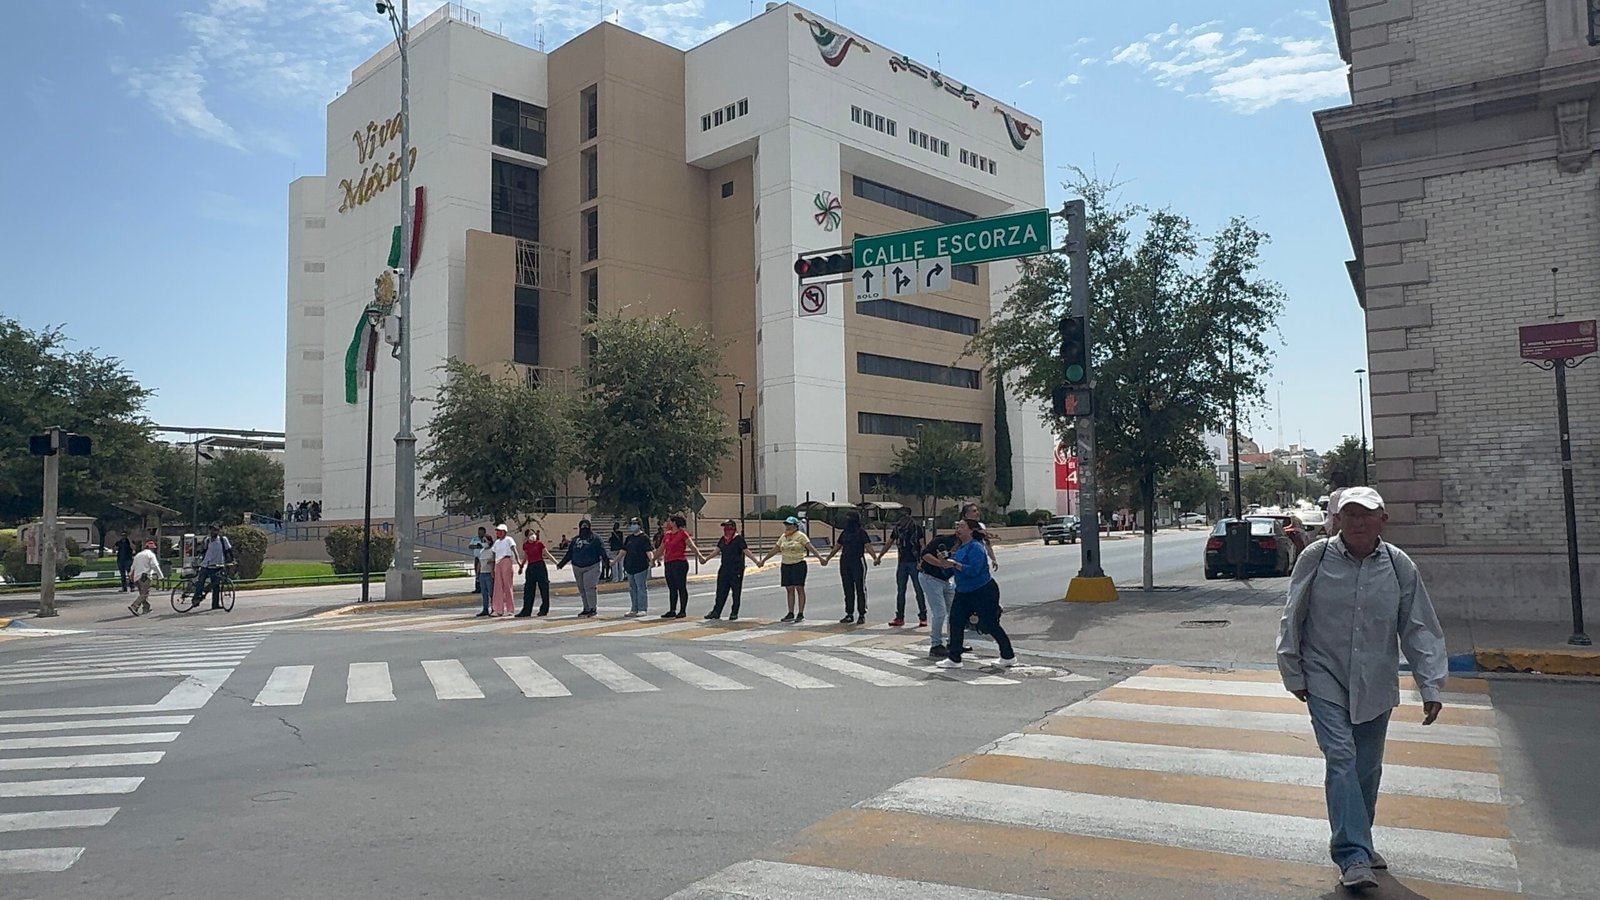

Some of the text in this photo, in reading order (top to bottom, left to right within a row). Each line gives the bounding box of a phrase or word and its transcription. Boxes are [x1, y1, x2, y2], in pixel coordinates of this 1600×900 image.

[352, 112, 402, 164] Viva
[862, 224, 1037, 266] CALLE ESCORZA
[857, 293, 879, 301] SOLO
